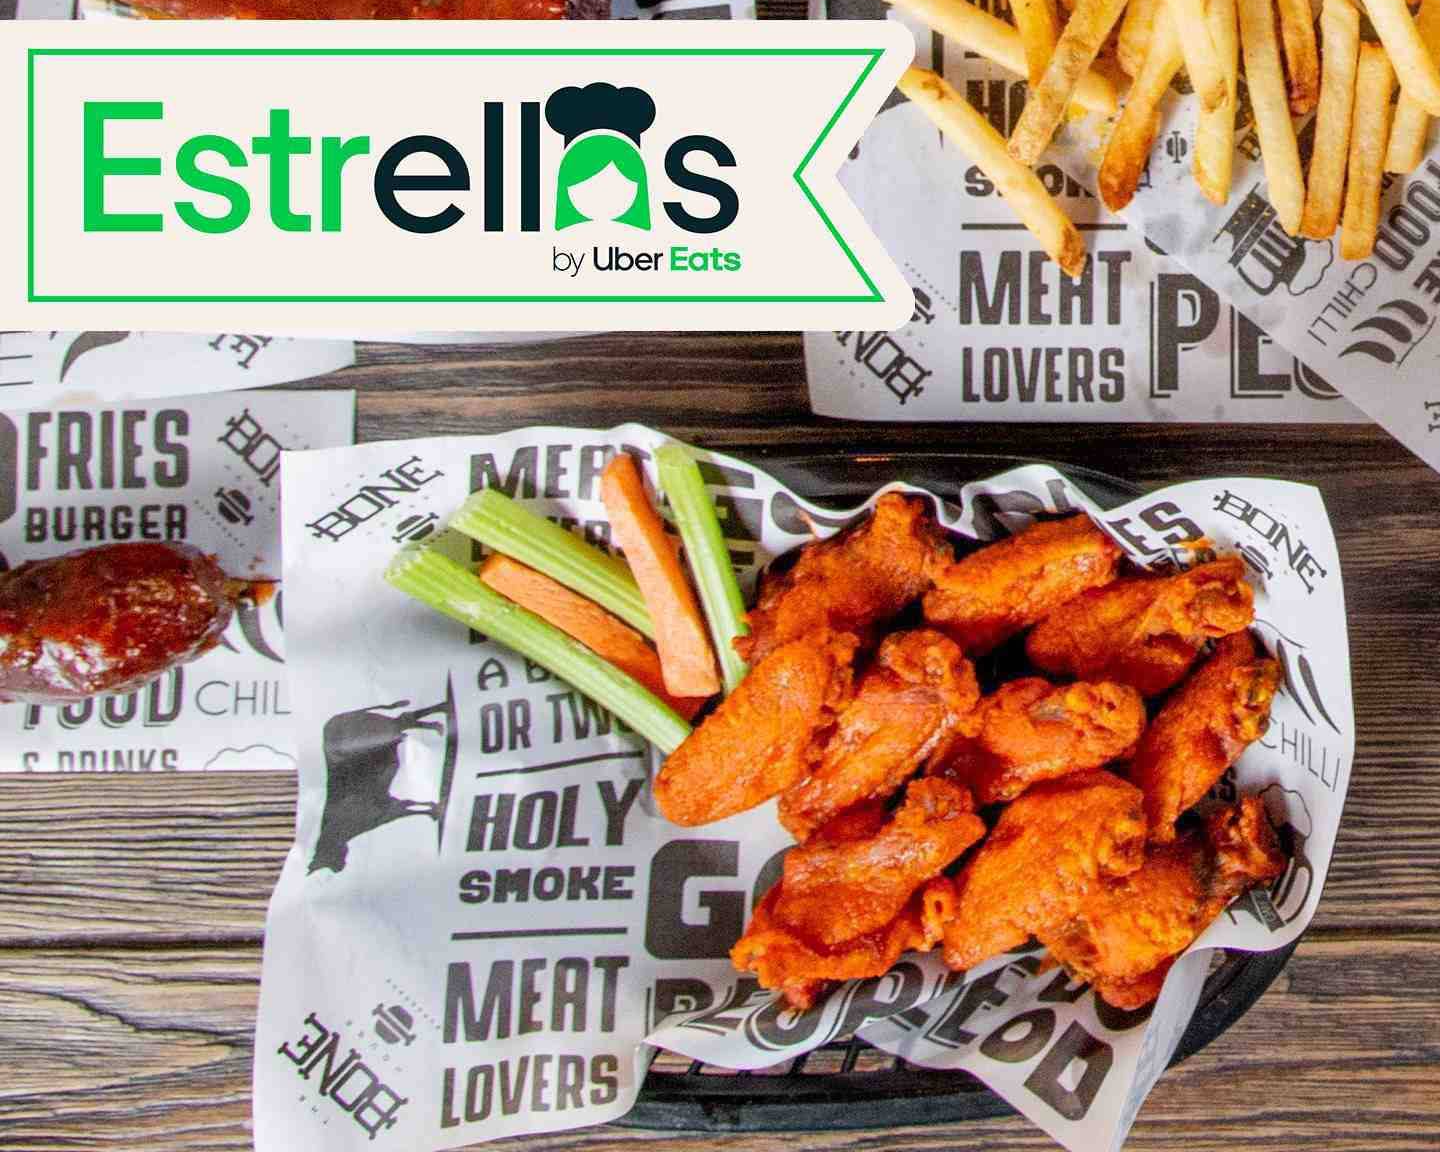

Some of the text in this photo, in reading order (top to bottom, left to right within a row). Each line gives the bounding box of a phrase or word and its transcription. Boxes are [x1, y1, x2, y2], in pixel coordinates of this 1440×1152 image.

[959, 250, 1132, 325] MEAT
[1307, 261, 1379, 347] CHILLI
[836, 330, 932, 405] BON
[962, 347, 1125, 403] LOVERS
[26, 408, 189, 491] FRIES
[25, 504, 188, 543] BURGER
[304, 456, 445, 542] BONE
[1213, 490, 1327, 595] BONE
[477, 657, 509, 691] A
[480, 698, 532, 754] OR
[465, 779, 644, 853] HOLY
[459, 865, 636, 904] SMOKE
[443, 955, 630, 1044] MEAT
[277, 1012, 409, 1141] BONE
[440, 1053, 620, 1129] LOVERS
